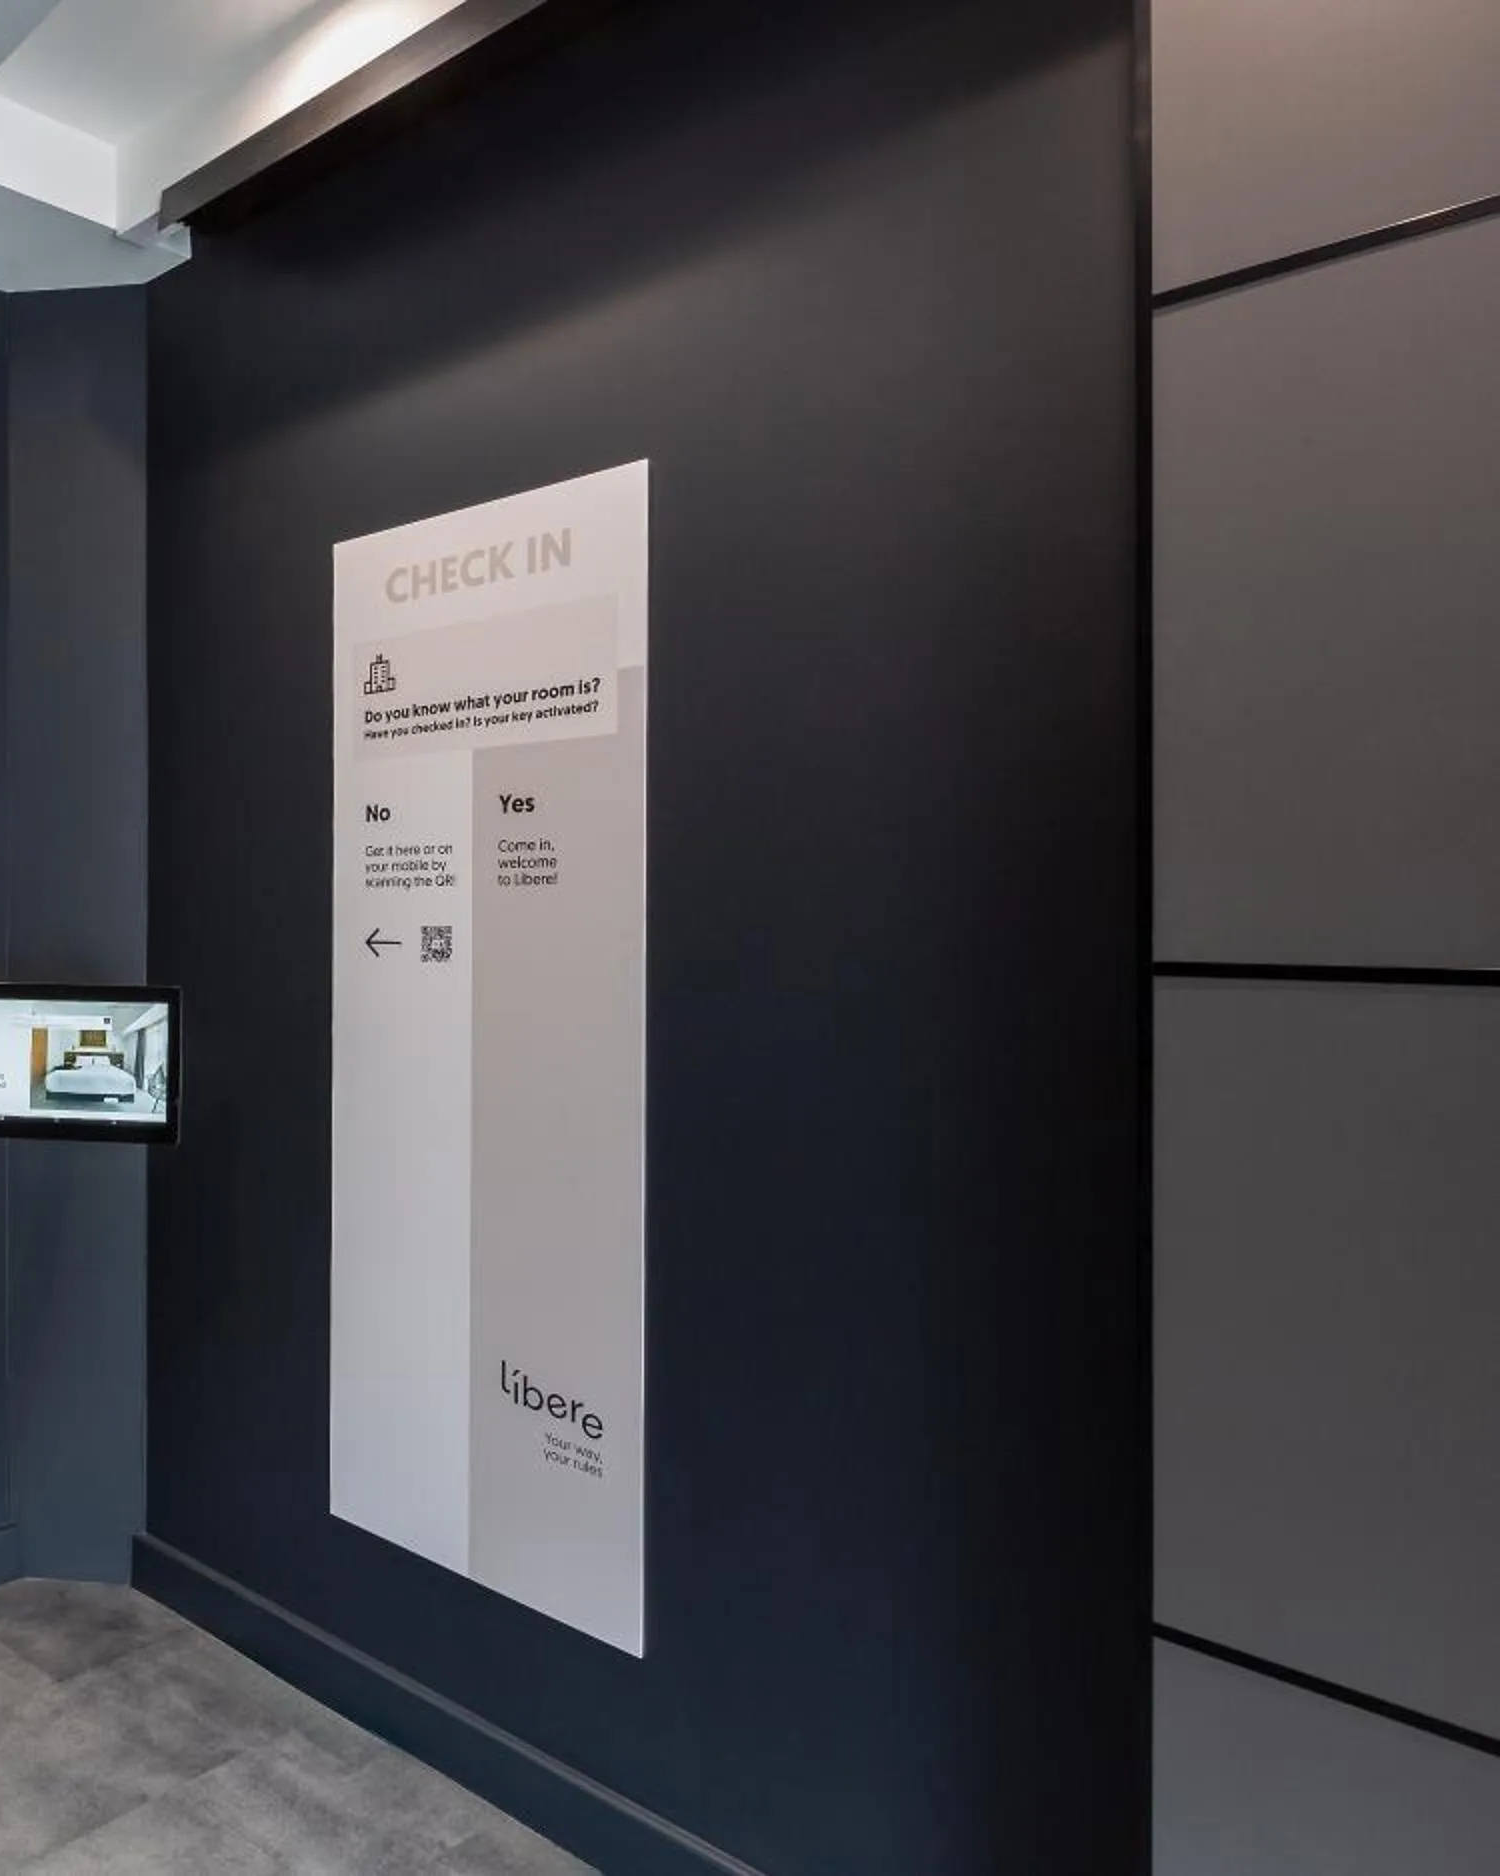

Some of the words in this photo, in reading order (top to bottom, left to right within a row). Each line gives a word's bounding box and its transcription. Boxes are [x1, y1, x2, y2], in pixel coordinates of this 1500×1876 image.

[385, 541, 514, 604] CHECK
[527, 527, 571, 576] IN
[365, 710, 382, 724] Do
[385, 707, 409, 723] you
[413, 703, 450, 719] know
[454, 696, 490, 712] what
[493, 691, 528, 708] your
[531, 684, 574, 700] room
[578, 677, 601, 696] is?
[364, 729, 388, 740] Have
[390, 726, 409, 740] you
[411, 719, 452, 736] checked
[455, 716, 471, 730] in?
[473, 716, 483, 727] Is
[484, 713, 510, 728] your
[512, 710, 533, 725] key
[535, 700, 600, 719] activated?
[365, 804, 391, 823] No
[499, 794, 536, 814] Yes
[365, 845, 385, 857] Get
[387, 845, 393, 856] it
[395, 844, 421, 857] here
[423, 845, 435, 855] or
[437, 844, 453, 855] on
[498, 838, 536, 852] Come
[539, 838, 555, 852] in,
[365, 862, 389, 874] your
[391, 859, 429, 872] mobile
[432, 859, 447, 874] by
[498, 855, 557, 869] welcome
[365, 875, 411, 889] scanning
[414, 875, 433, 886] the
[498, 874, 511, 886] to
[501, 1359, 603, 1440] líbere
[573, 1459, 603, 1479] rules
